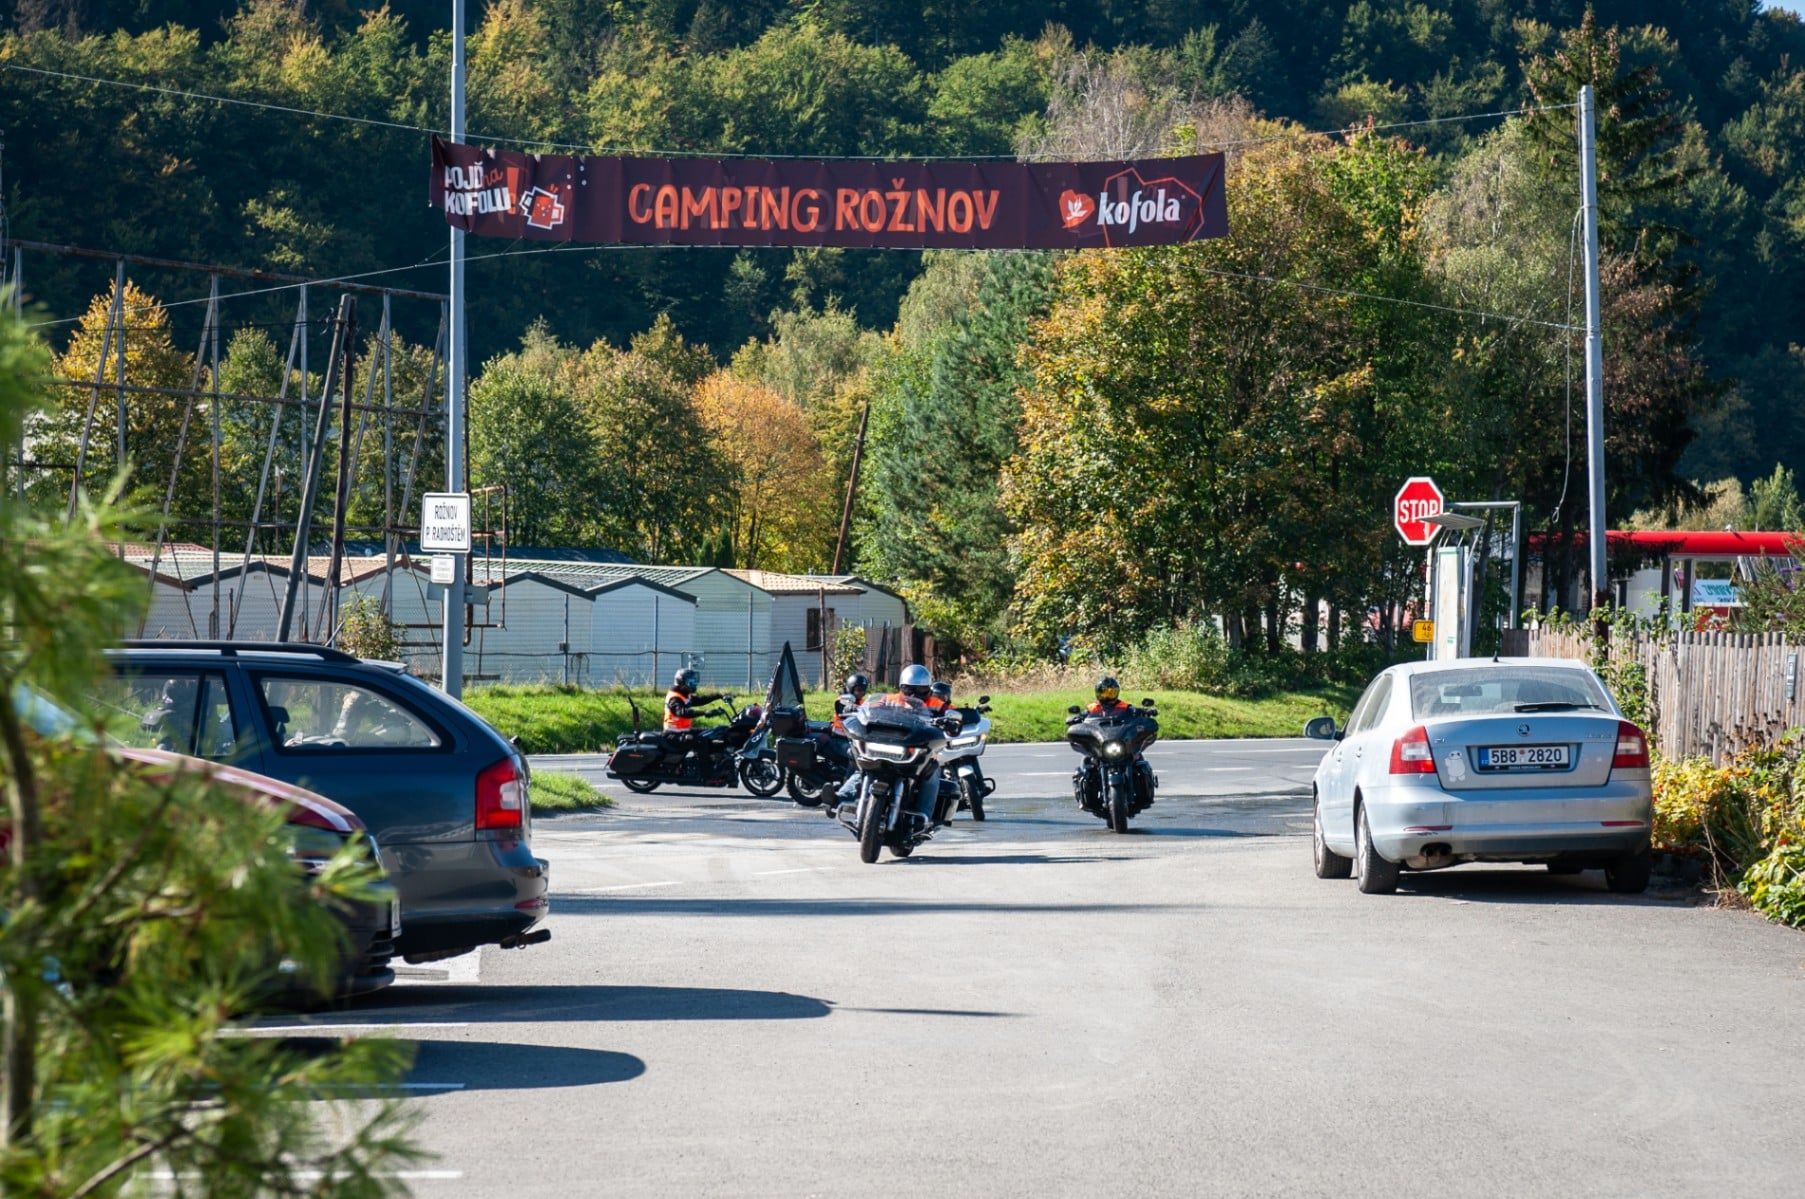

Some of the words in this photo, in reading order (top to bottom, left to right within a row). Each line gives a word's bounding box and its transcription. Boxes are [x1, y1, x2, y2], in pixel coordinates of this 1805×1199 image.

[628, 183, 819, 233] CAMPING
[835, 177, 1000, 233] ROŽNOV
[1096, 188, 1181, 234] kofola
[1399, 499, 1439, 524] STOP
[1491, 749, 1517, 764] 5B8
[1527, 748, 1562, 763] 2820
